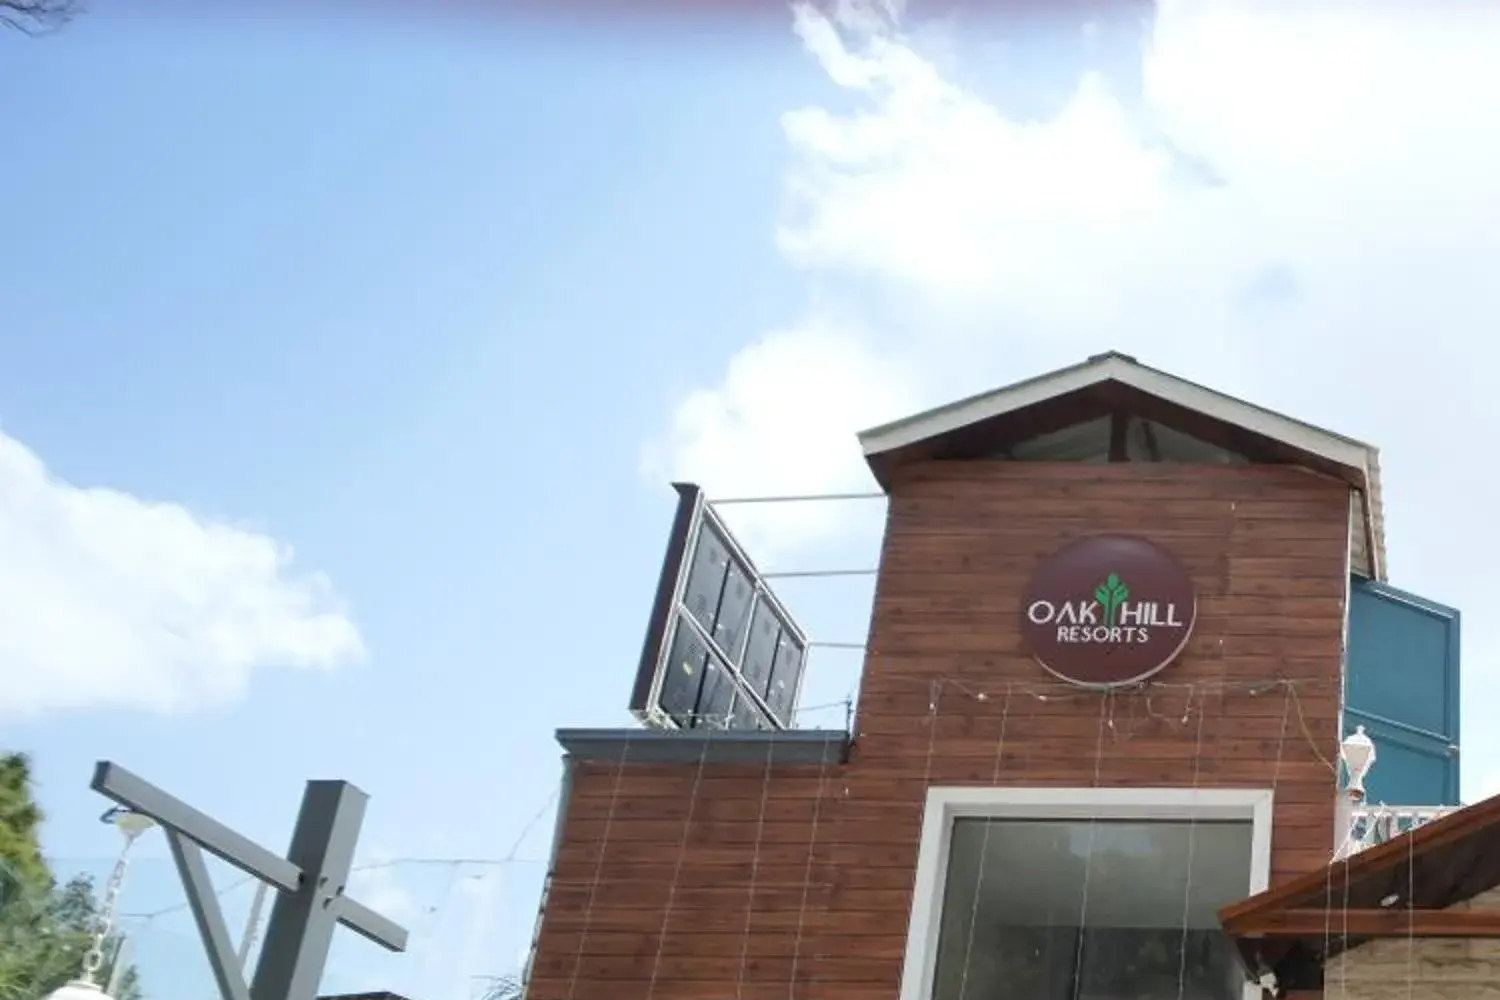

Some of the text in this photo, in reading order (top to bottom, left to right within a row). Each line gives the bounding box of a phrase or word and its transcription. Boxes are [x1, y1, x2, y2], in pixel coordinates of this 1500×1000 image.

[1028, 600, 1182, 626] OAK HILL
[1057, 625, 1149, 643] RESORTS
